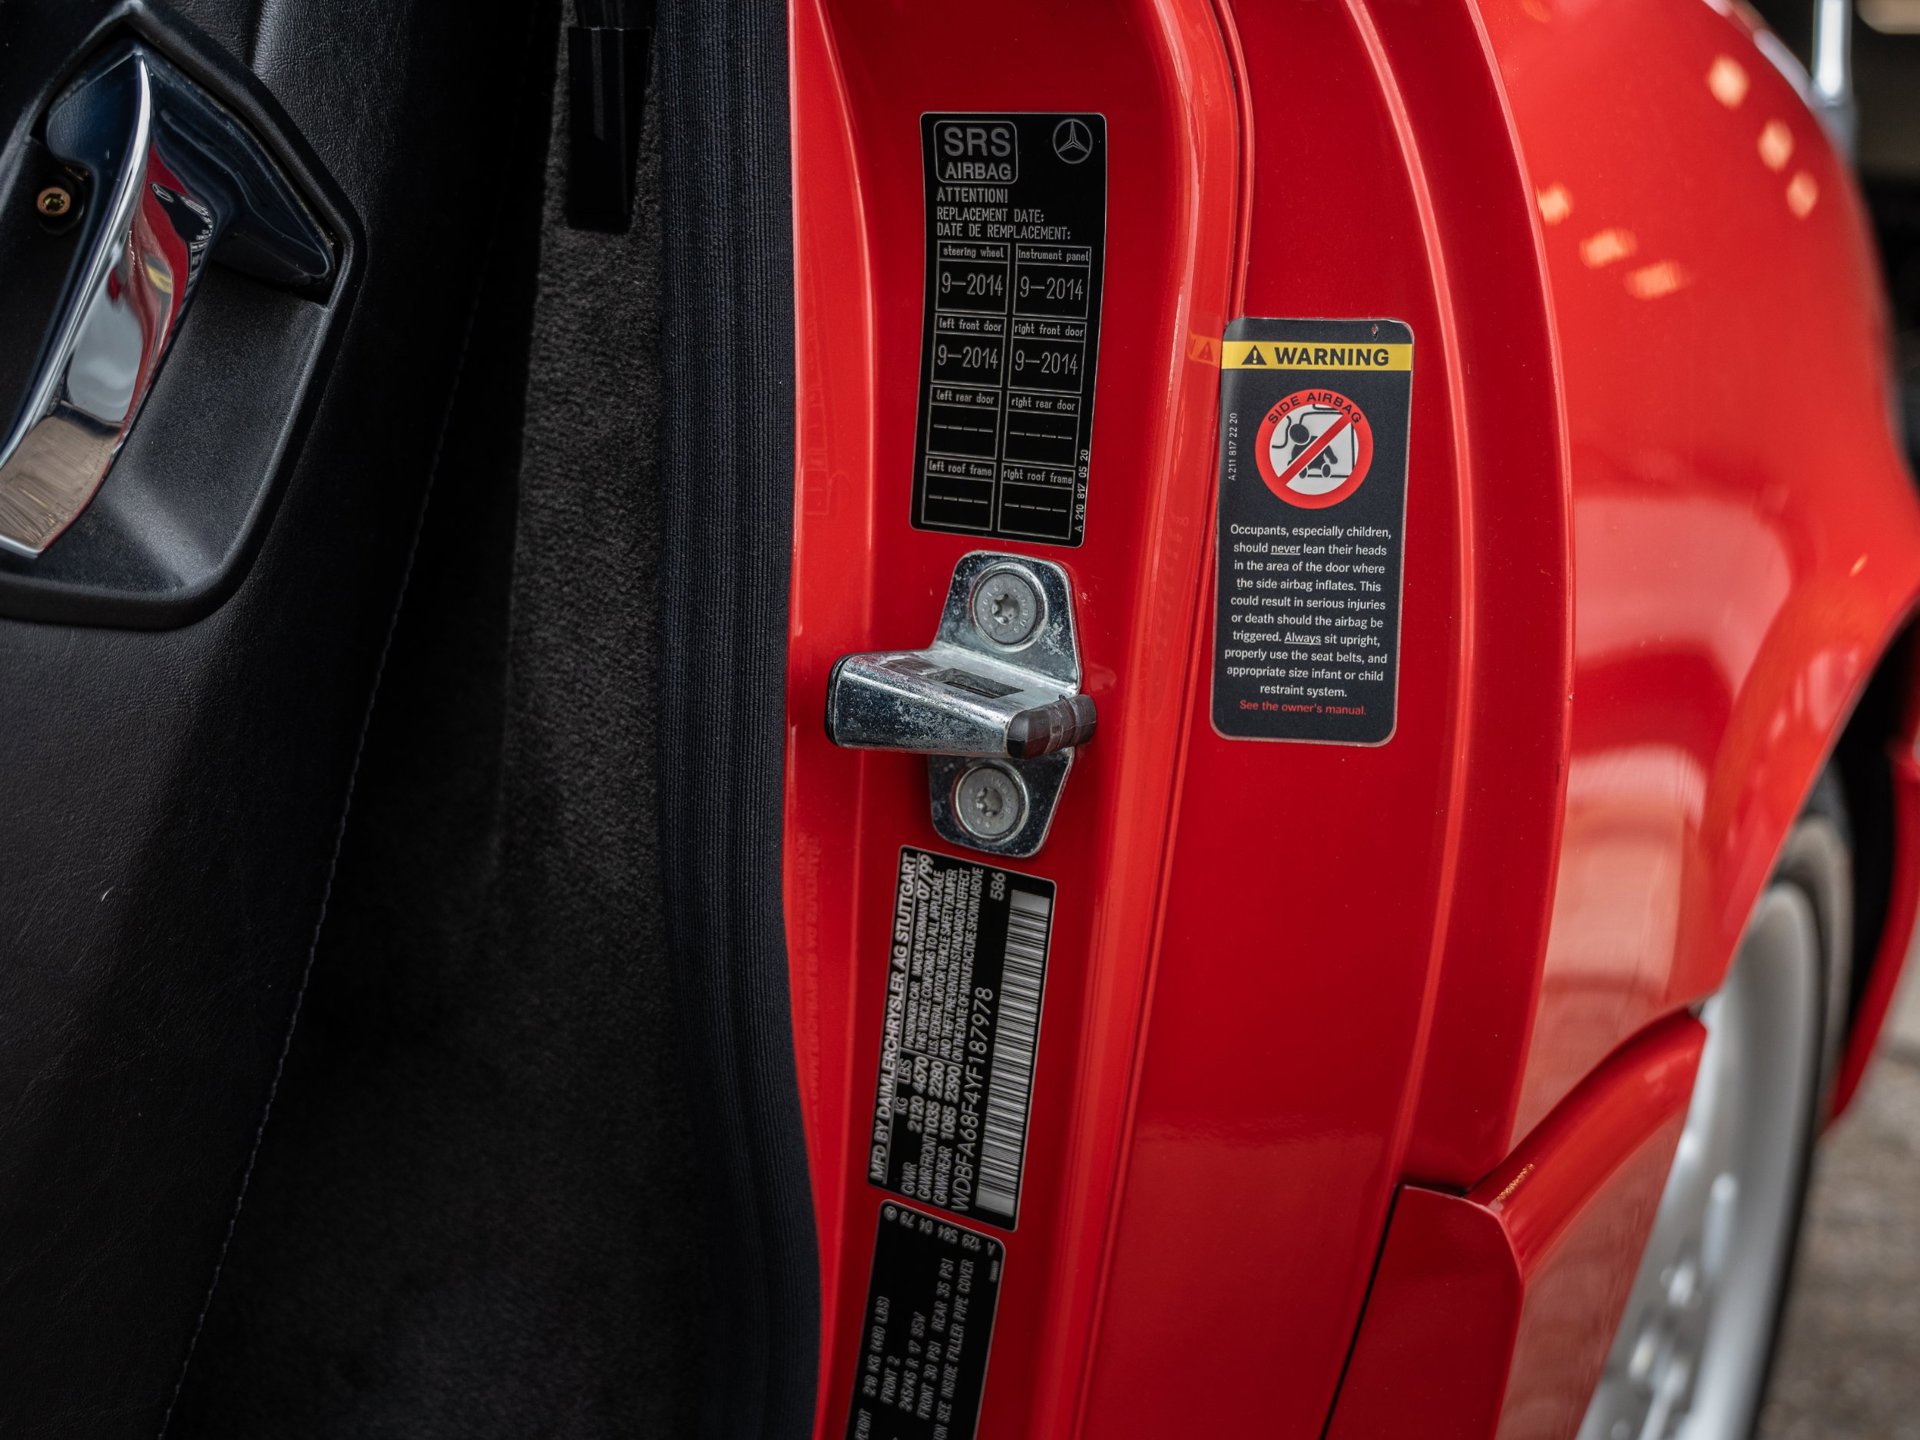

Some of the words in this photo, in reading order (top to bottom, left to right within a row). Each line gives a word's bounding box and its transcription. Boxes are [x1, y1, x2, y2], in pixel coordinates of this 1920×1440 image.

[944, 127, 1011, 157] SRS
[945, 162, 1011, 180] AIRBAG
[937, 187, 1008, 203] ATTENTION!
[937, 207, 1008, 222] REPLACEMENT
[1014, 209, 1044, 223] DATE:
[937, 223, 962, 236] DATE
[969, 224, 981, 237] DE
[987, 225, 1071, 240] REMPLACEMENT:
[943, 246, 976, 258] steering
[981, 247, 1004, 258] wheel
[1067, 251, 1089, 262] panel
[939, 318, 955, 329] left
[959, 319, 979, 331] front
[984, 320, 1002, 331] door
[1015, 322, 1035, 335] right
[1039, 324, 1060, 335] front
[1065, 325, 1083, 337] door
[1274, 347, 1389, 366] WARNING
[936, 389, 952, 401] left
[956, 392, 972, 402] rear
[977, 393, 994, 404] door
[1011, 397, 1031, 408] right
[1036, 399, 1052, 409] rear
[1057, 400, 1075, 411] door
[1268, 396, 1300, 424] SIDE
[1306, 392, 1362, 424] AIRBAG
[1229, 413, 1238, 424] 20
[1229, 427, 1237, 437] 22
[1080, 449, 1088, 461] 20
[928, 460, 944, 472] left
[948, 462, 965, 473] roof
[970, 464, 992, 476] frame
[1003, 468, 1023, 480] right
[1027, 470, 1046, 481] roof
[1050, 472, 1072, 485] frame
[1078, 466, 1087, 478] 05
[1076, 483, 1086, 500] 817
[1075, 504, 1084, 520] 210
[1230, 524, 1289, 537] Occupants,
[1292, 526, 1344, 539] especially
[1346, 526, 1391, 539] children,
[1234, 542, 1268, 553] should
[1271, 545, 1300, 555] never
[1303, 544, 1325, 554] lean
[1328, 544, 1353, 555] their
[1355, 545, 1387, 555] heads
[1235, 560, 1243, 570] in
[1247, 560, 1263, 570] the
[1266, 563, 1289, 571] area
[1292, 561, 1303, 571] of
[1305, 562, 1322, 572] the
[1325, 562, 1350, 572] door
[1352, 563, 1385, 574] where
[1237, 578, 1253, 588] the
[1256, 578, 1277, 588] side
[1280, 579, 1313, 592] airbag
[1316, 580, 1356, 591] inflates.
[1360, 581, 1381, 592] This
[1230, 596, 1258, 606] could
[1262, 596, 1291, 607] result
[1294, 597, 1303, 607] in
[1306, 598, 1344, 608] serious
[1348, 599, 1386, 611] injuries
[1231, 615, 1243, 623] or
[1245, 613, 1274, 624] death
[1277, 615, 1312, 625] should
[1315, 615, 1331, 626] the
[1335, 617, 1367, 629] airbag
[1371, 617, 1383, 628] be
[1233, 630, 1282, 644] triggered.
[1284, 631, 1321, 645] Always
[1325, 634, 1337, 644] sit
[1340, 635, 1380, 648] upright,
[1225, 648, 1267, 661] properly
[1270, 651, 1288, 660] use
[1291, 650, 1308, 661] the
[1311, 651, 1333, 662] seat
[1337, 652, 1365, 664] belts,
[1368, 653, 1388, 664] and
[1227, 666, 1286, 679] appropriate
[1289, 668, 1308, 678] size
[1312, 668, 1341, 680] infant
[1344, 671, 1356, 680] or
[1358, 670, 1383, 681] child
[1260, 684, 1304, 695] restraint
[1307, 687, 1347, 698] system.
[1240, 700, 1259, 710] See
[1261, 700, 1279, 711] the
[1282, 702, 1322, 713] owner's
[1325, 704, 1366, 715] manual.
[916, 854, 934, 900] 07/99
[989, 872, 1006, 901] 586
[895, 852, 916, 943] STUTTGART
[892, 945, 907, 970] AG
[876, 971, 905, 1119] DAIMLERCHRYSLER
[896, 1056, 912, 1084] LBS
[912, 1055, 929, 1093] 4670
[928, 1060, 945, 1098] 2280
[944, 1065, 961, 1103] 2390
[893, 1096, 908, 1114] KG
[951, 987, 993, 1210] WDBFA68F4YF187978
[907, 1095, 925, 1132] 2120
[924, 1100, 941, 1134] 1035
[940, 1105, 957, 1139] 1085
[874, 1119, 890, 1143] BY
[919, 1132, 937, 1168] FRONT
[870, 1144, 887, 1183] MFD
[935, 1145, 952, 1174] REAR
[901, 1161, 917, 1195] GVWR
[917, 1167, 933, 1200] GAWR
[932, 1172, 949, 1205] GAWR
[939, 1257, 954, 1278] PSI
[957, 1259, 974, 1293] COVER
[936, 1280, 951, 1297] 35
[931, 1300, 947, 1331] REAR
[952, 1294, 969, 1321] PIPE
[926, 1340, 941, 1362] PSI
[946, 1323, 964, 1361] FILLER
[886, 1355, 900, 1366] 2
[923, 1363, 938, 1380] 30
[941, 1363, 958, 1398] INSIDE
[880, 1367, 897, 1403] FRONT
[917, 1382, 934, 1419] FRONT
[936, 1400, 952, 1422] SEE
